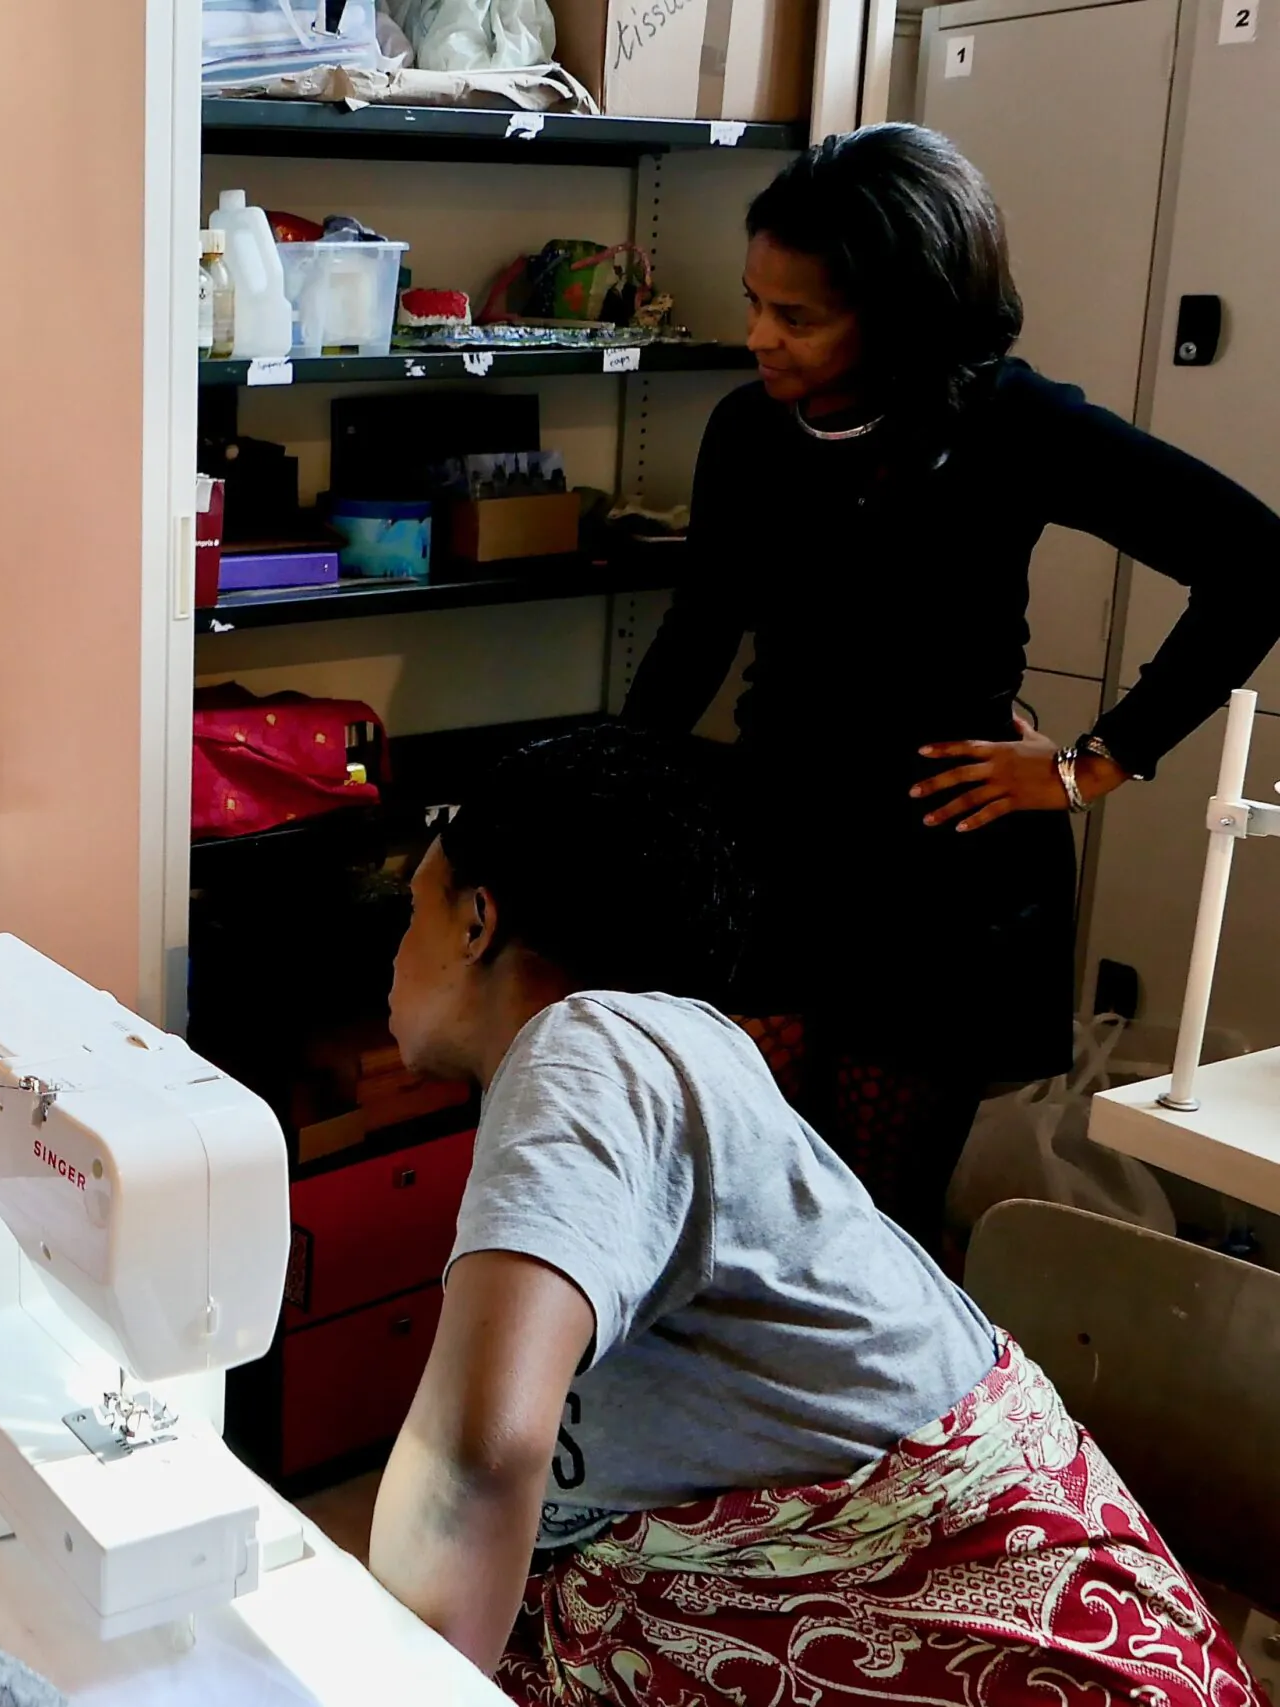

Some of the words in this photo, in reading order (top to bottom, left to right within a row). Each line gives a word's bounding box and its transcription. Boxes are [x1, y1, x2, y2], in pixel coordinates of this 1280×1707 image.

[613, 0, 692, 69] tissu
[1235, 9, 1250, 28] 2
[957, 47, 966, 63] 1
[33, 1140, 86, 1191] SINGER
